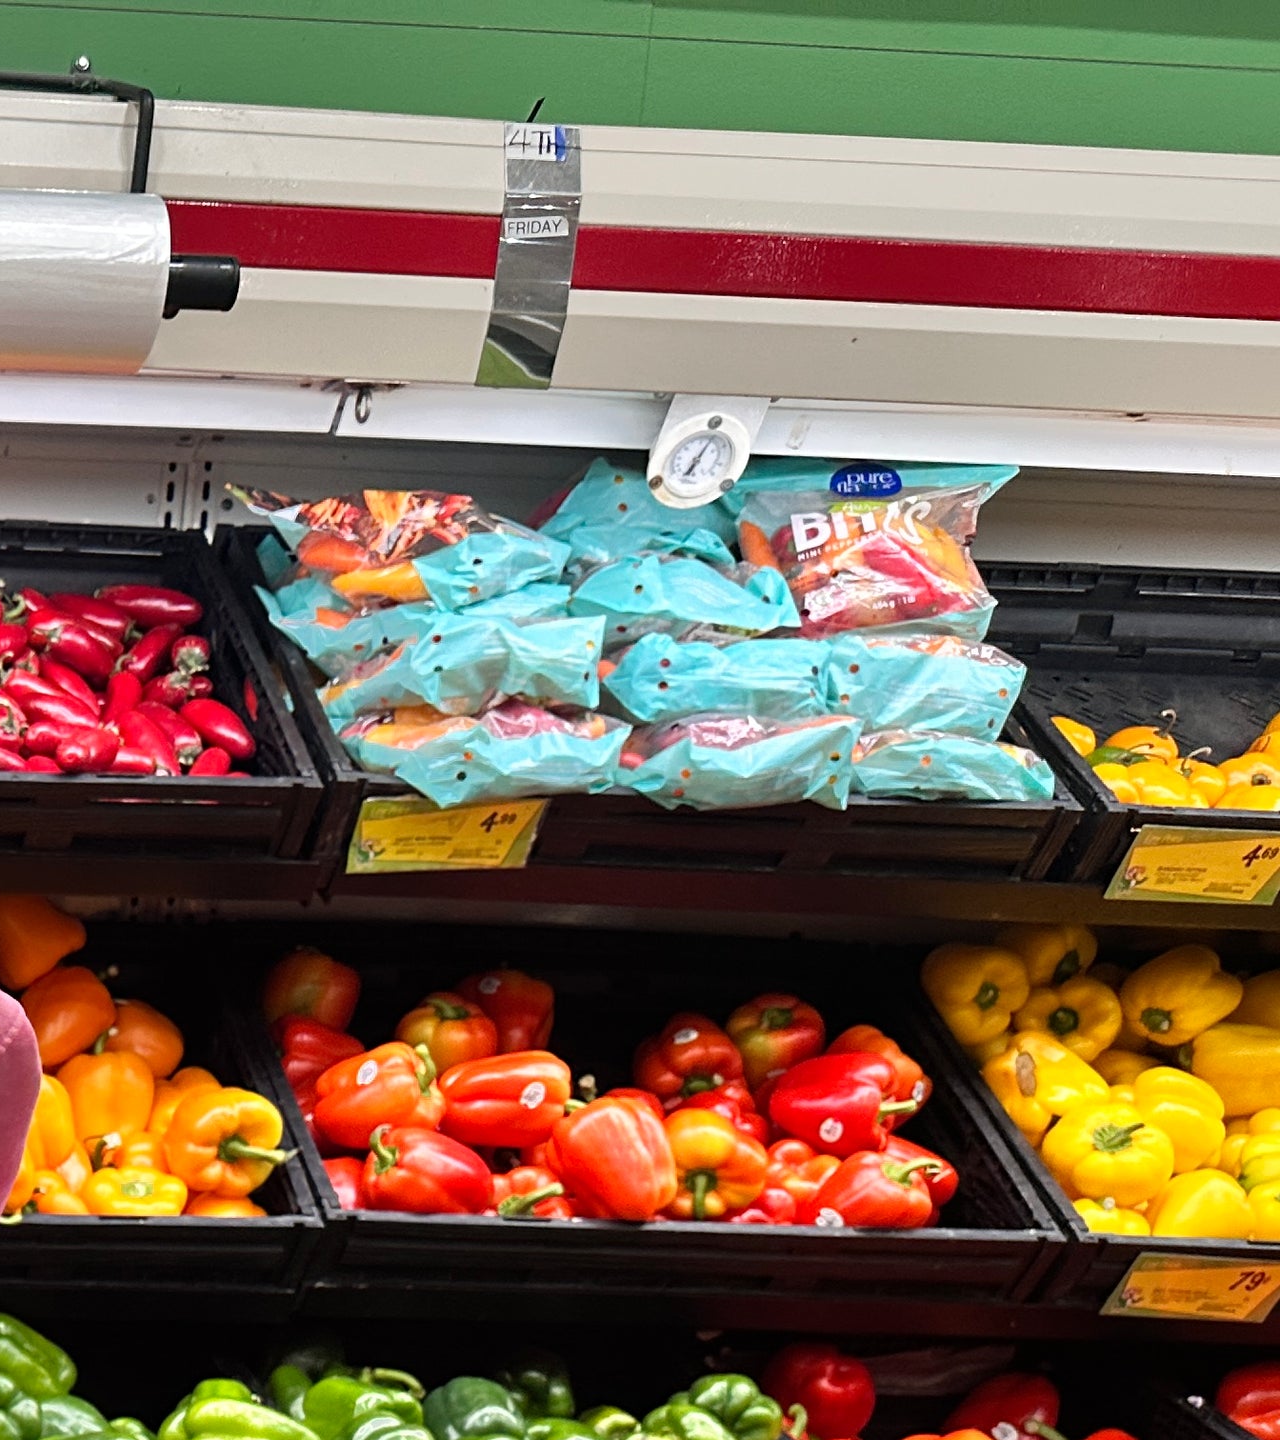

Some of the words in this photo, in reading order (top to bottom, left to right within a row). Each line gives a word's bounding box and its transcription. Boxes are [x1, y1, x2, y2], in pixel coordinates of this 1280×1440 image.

[508, 128, 559, 155] 4TH
[507, 220, 561, 236] FRIDAY
[847, 472, 892, 487] pure
